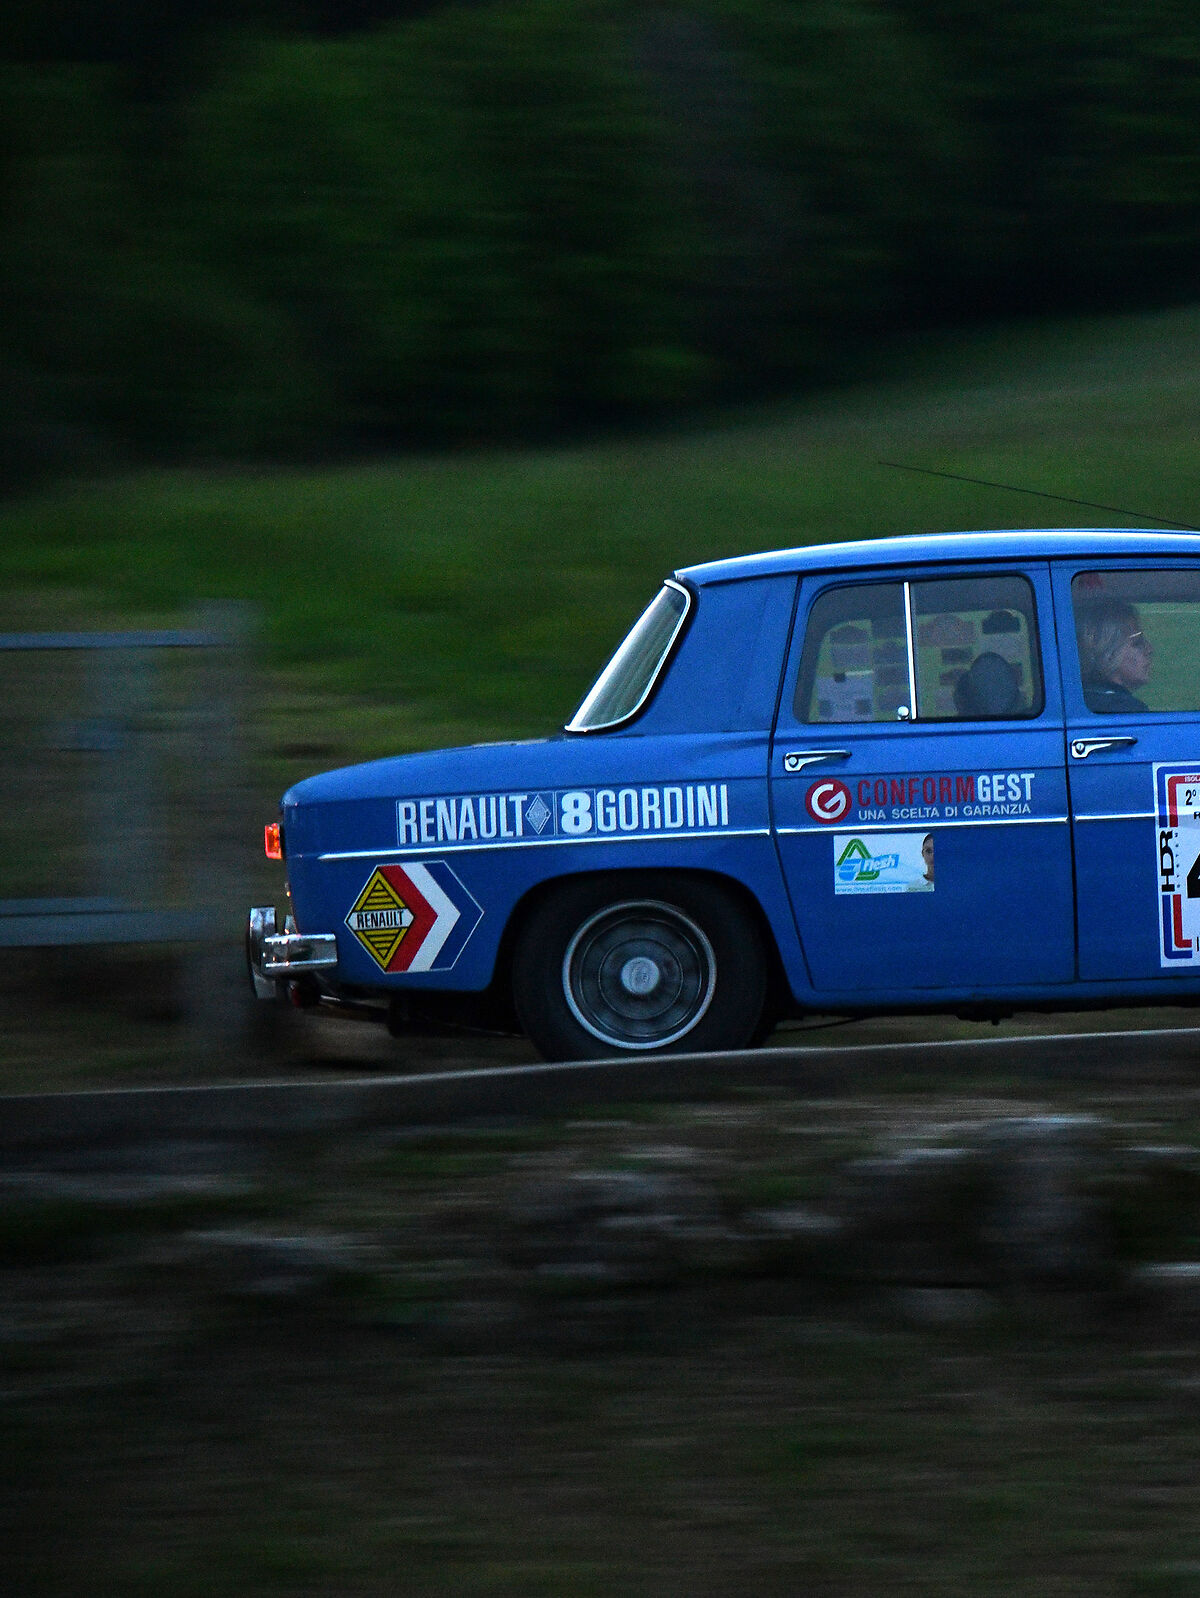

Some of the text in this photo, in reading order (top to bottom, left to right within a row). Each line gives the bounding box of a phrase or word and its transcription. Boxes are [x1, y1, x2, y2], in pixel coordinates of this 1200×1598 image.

[857, 773, 1035, 807] CONFORMGEST
[399, 784, 729, 845] RENAULT 8 GORDINI
[858, 803, 1032, 821] UNA SCELTA DI GARANZIA
[1160, 830, 1175, 892] HDR
[356, 910, 404, 928] RENAULT
